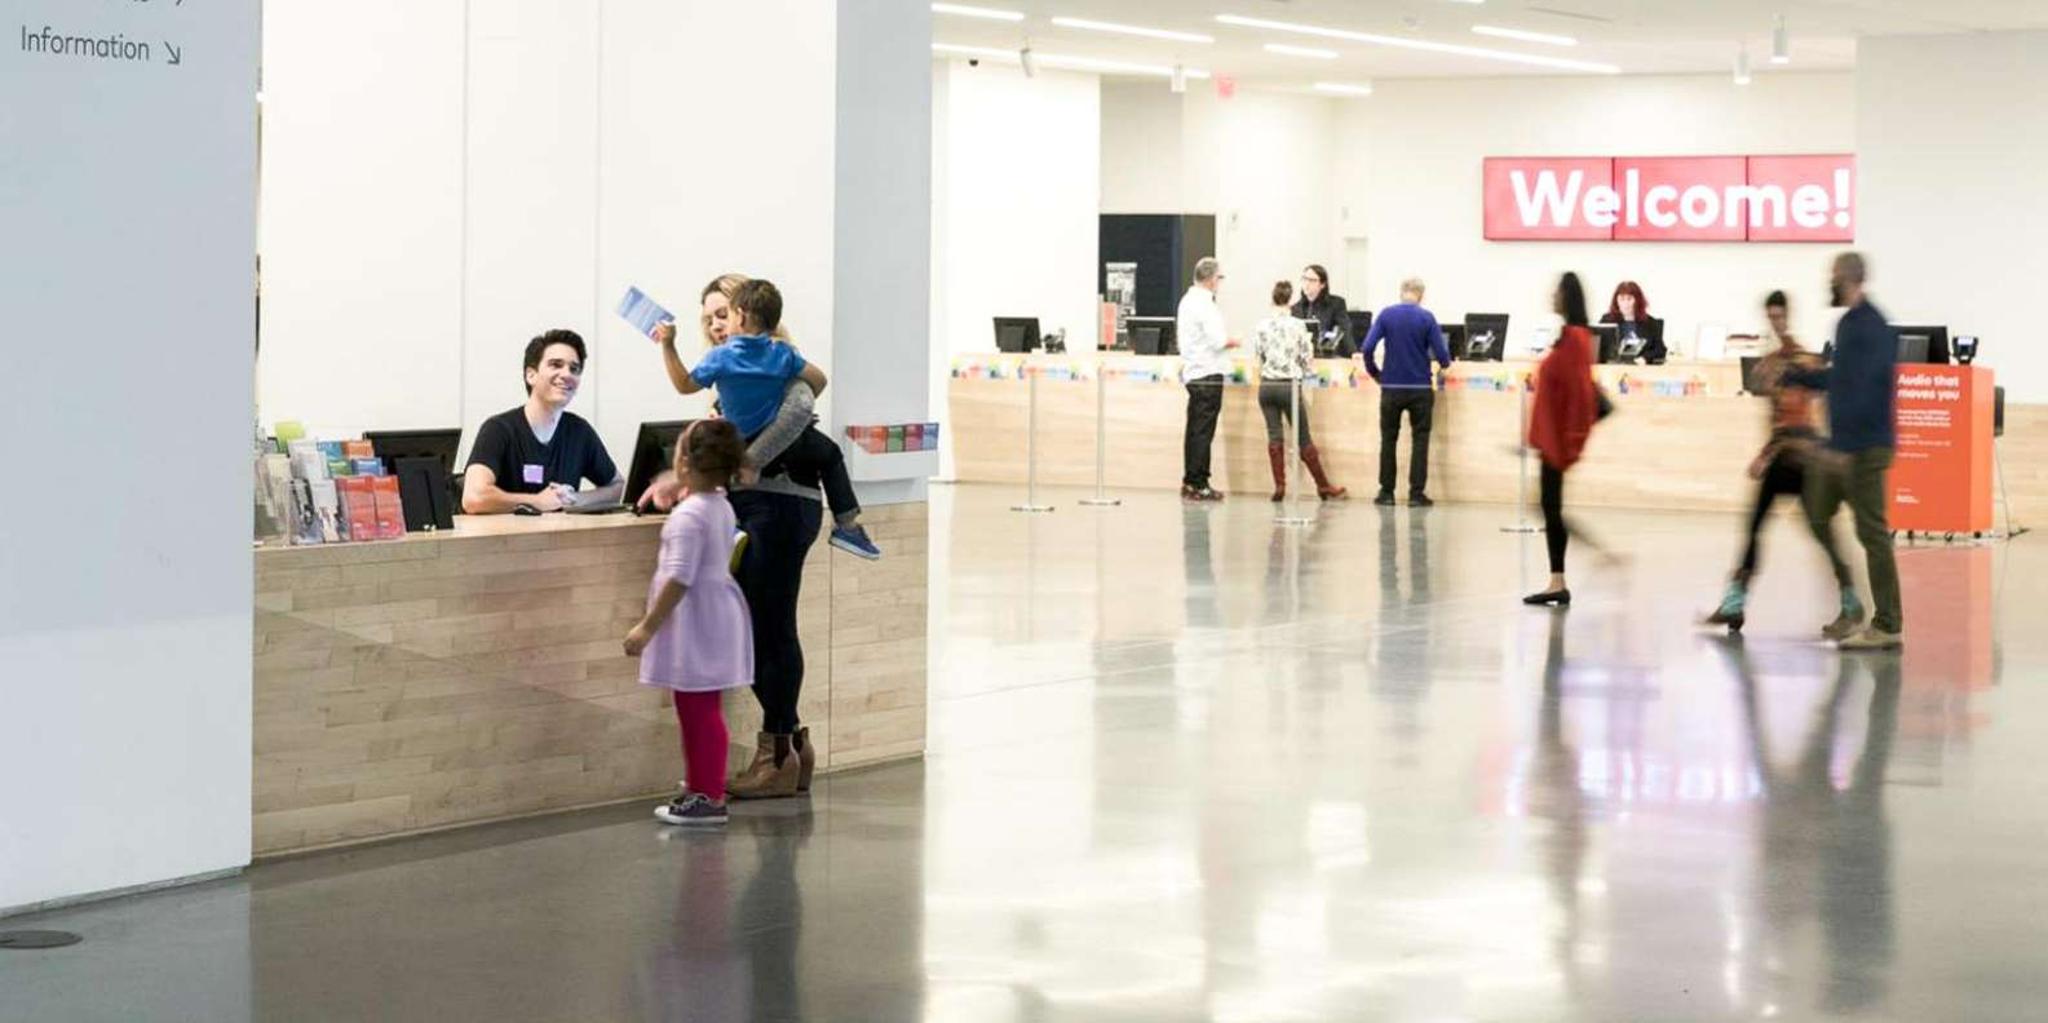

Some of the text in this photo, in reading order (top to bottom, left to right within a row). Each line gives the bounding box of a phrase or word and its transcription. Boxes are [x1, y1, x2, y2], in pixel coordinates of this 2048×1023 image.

[21, 25, 150, 61] Information
[1509, 168, 1850, 229] Welcome!
[1897, 372, 1959, 387] Audio that
[1897, 388, 1960, 401] moves you
